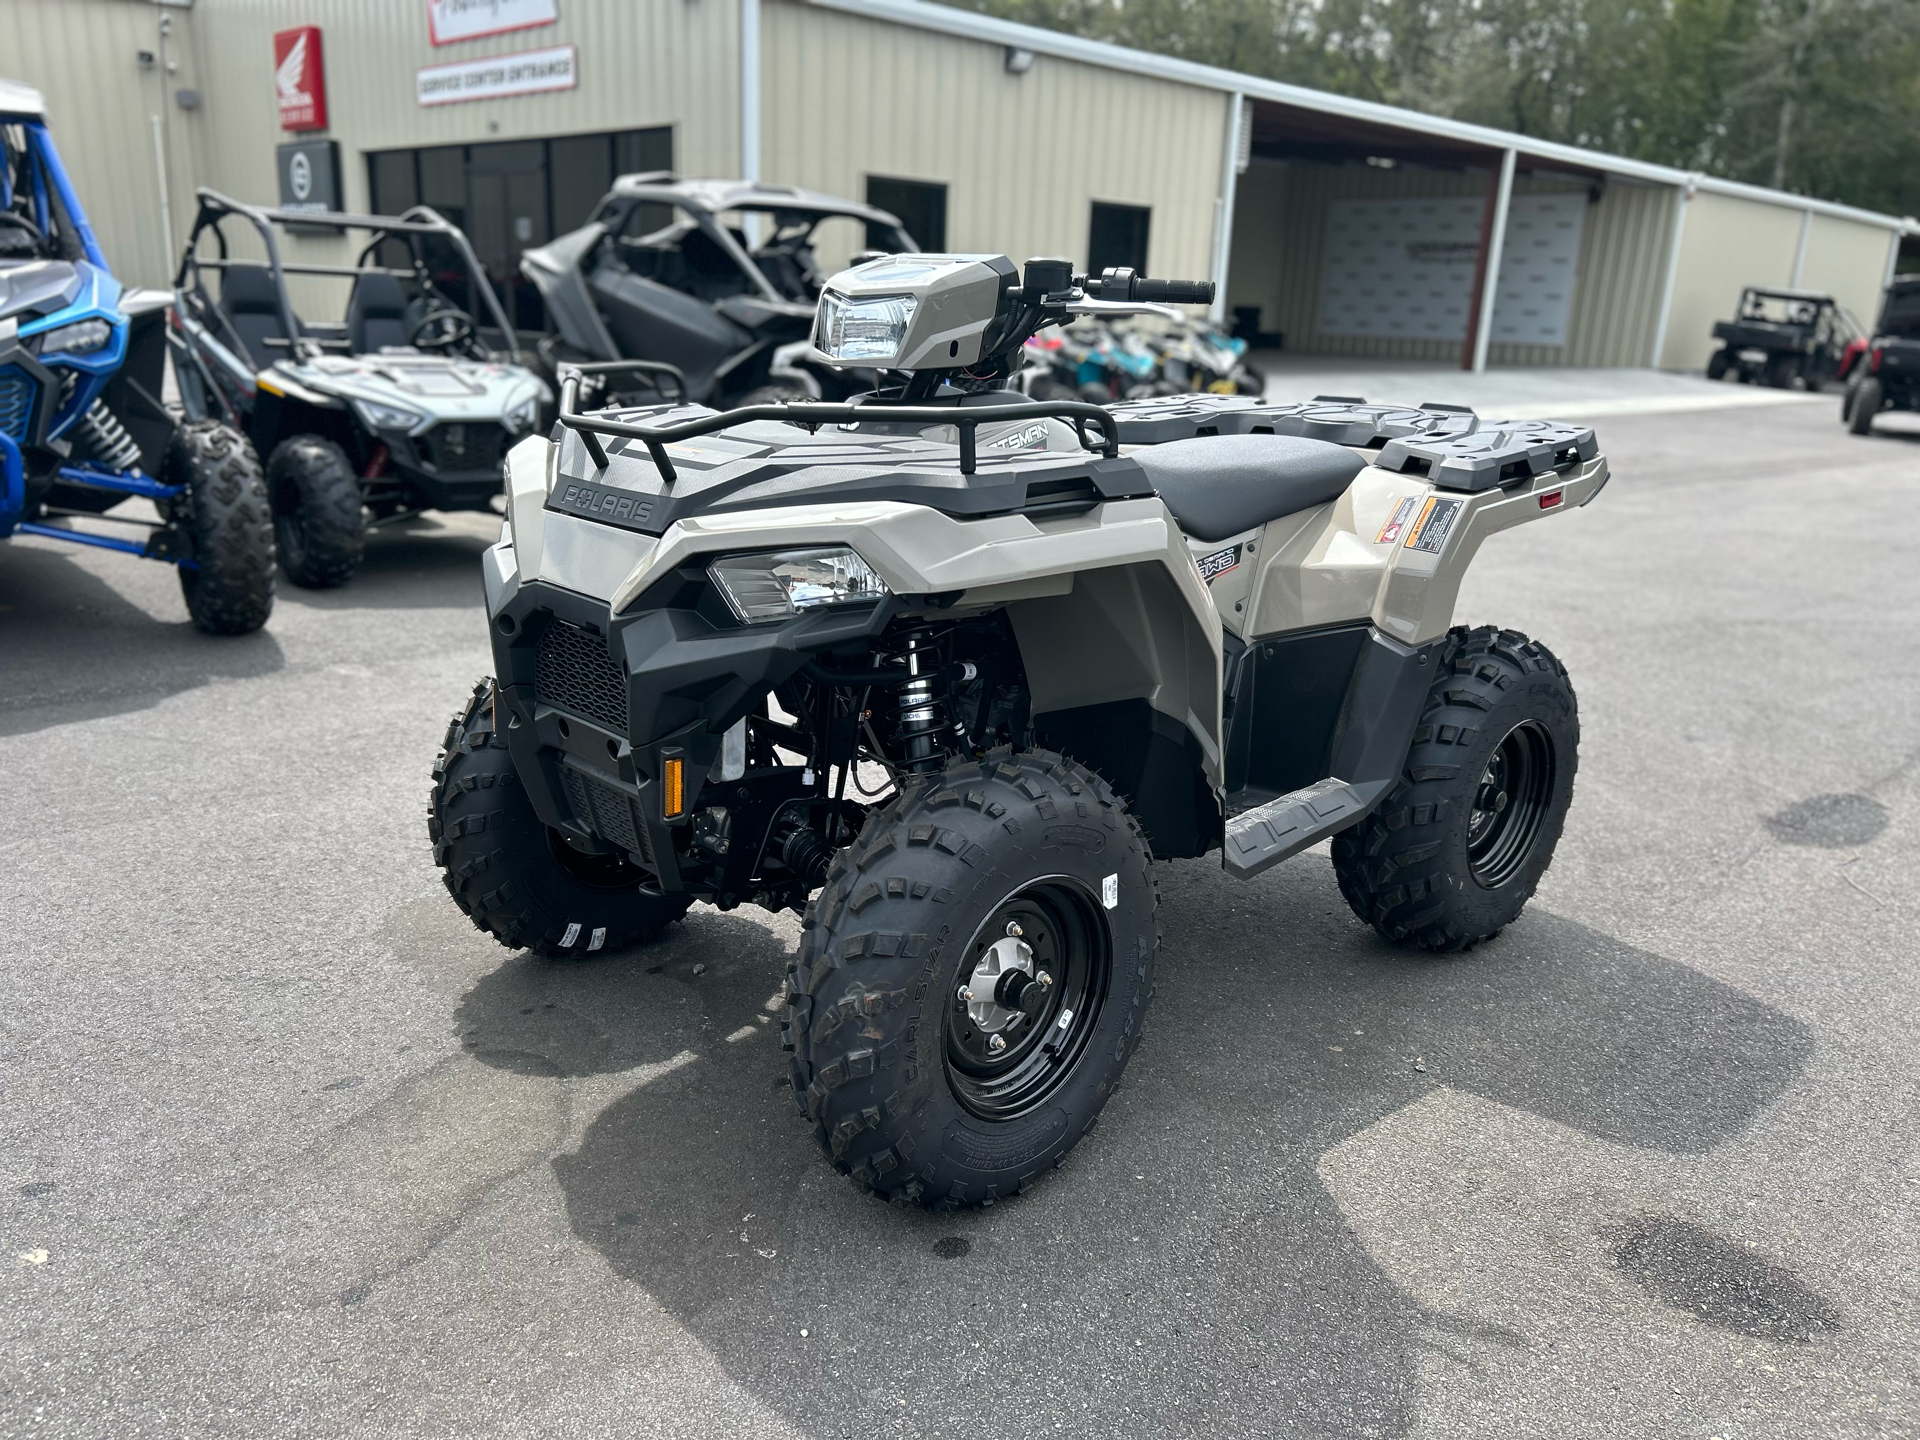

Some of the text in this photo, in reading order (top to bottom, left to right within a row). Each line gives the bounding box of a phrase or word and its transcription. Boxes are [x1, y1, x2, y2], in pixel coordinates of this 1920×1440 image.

[420, 58, 570, 94] SERVICE CENTER ENTRANCE
[987, 421, 1049, 448] TSMAN
[560, 484, 654, 523] POLARIS
[905, 923, 951, 1085] CARLSTAR
